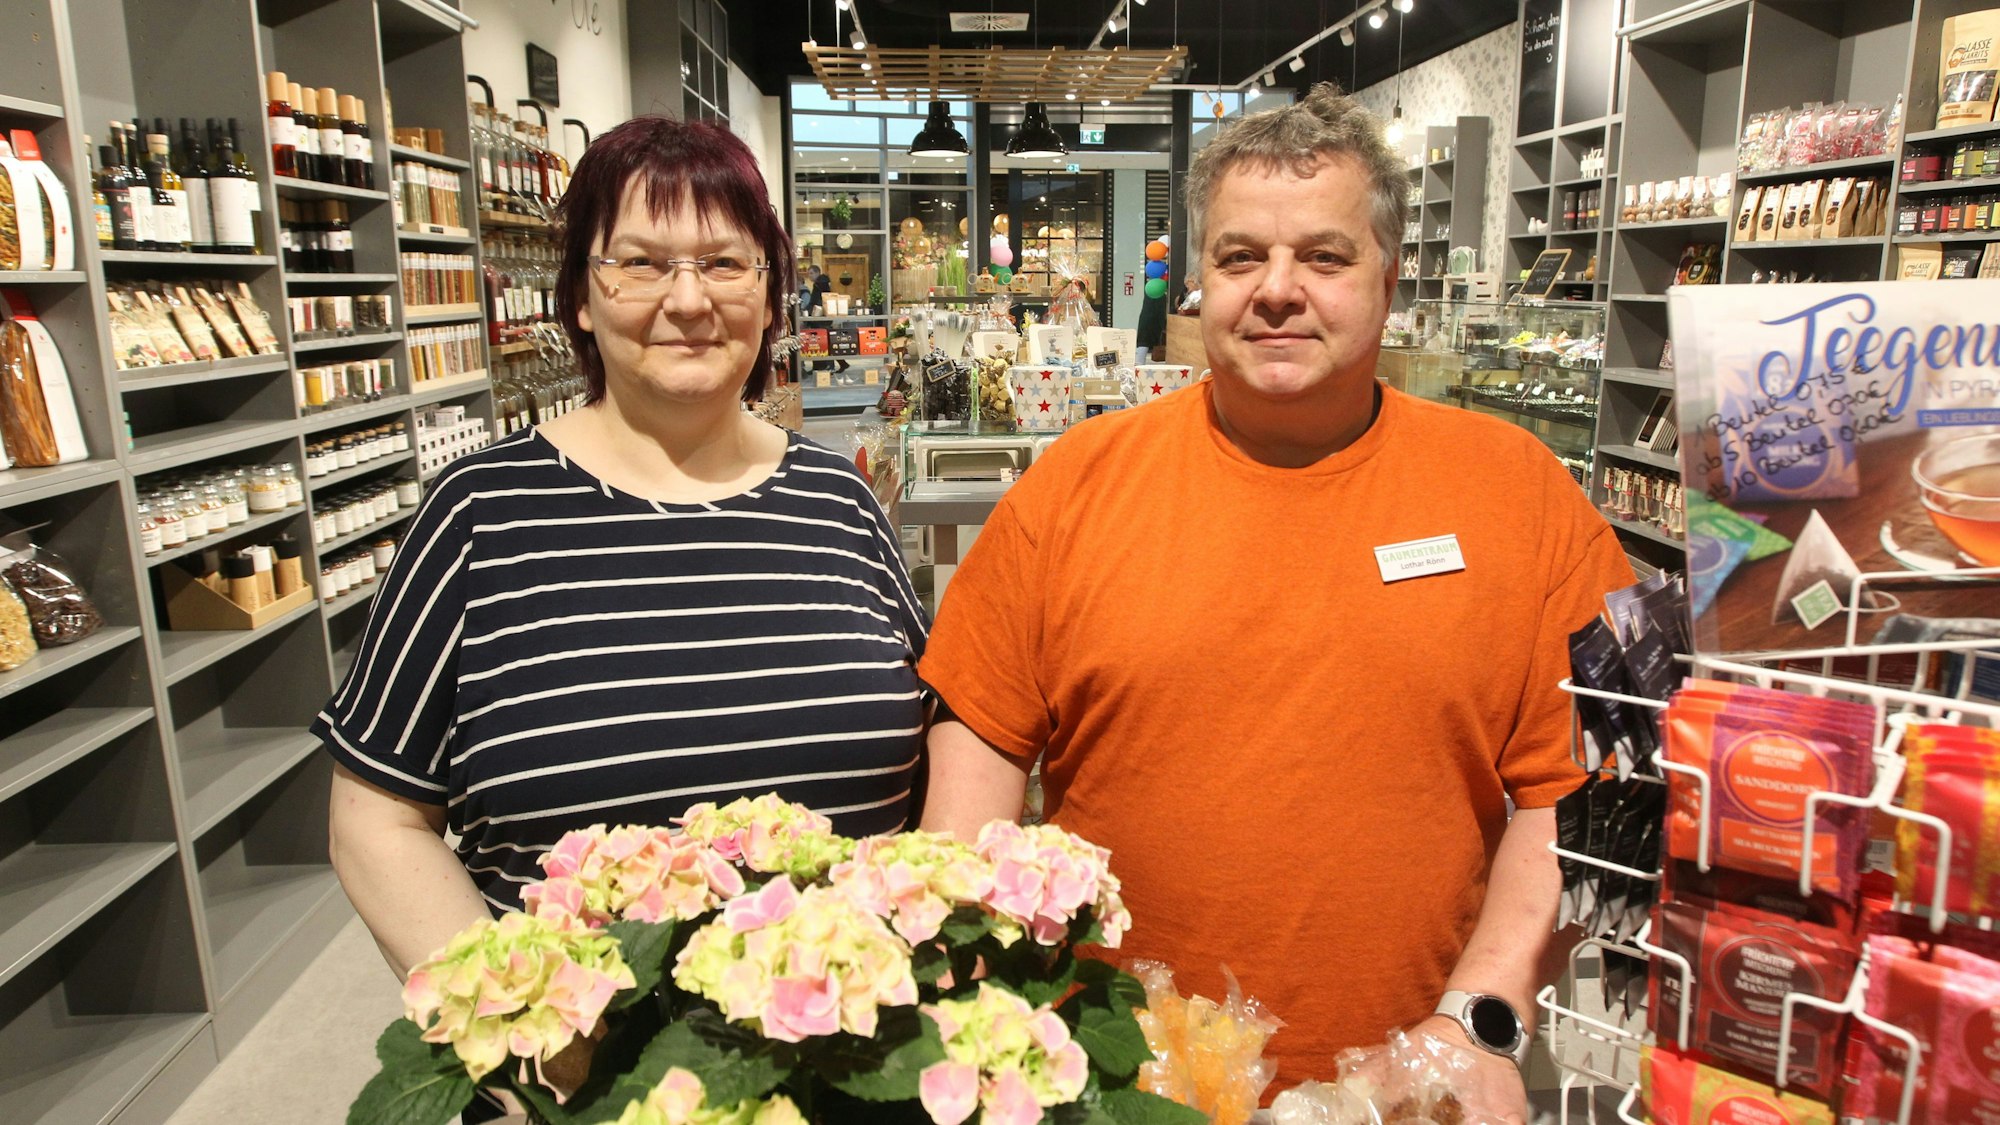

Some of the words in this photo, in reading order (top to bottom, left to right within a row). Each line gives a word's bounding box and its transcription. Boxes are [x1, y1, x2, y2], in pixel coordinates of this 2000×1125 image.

[1966, 38, 1992, 53] LASSE
[1724, 440, 1740, 462] 5
[1382, 542, 1458, 562] GAUMENTRAUM
[1401, 560, 1425, 570] Lothar
[1426, 557, 1446, 566] Rönn
